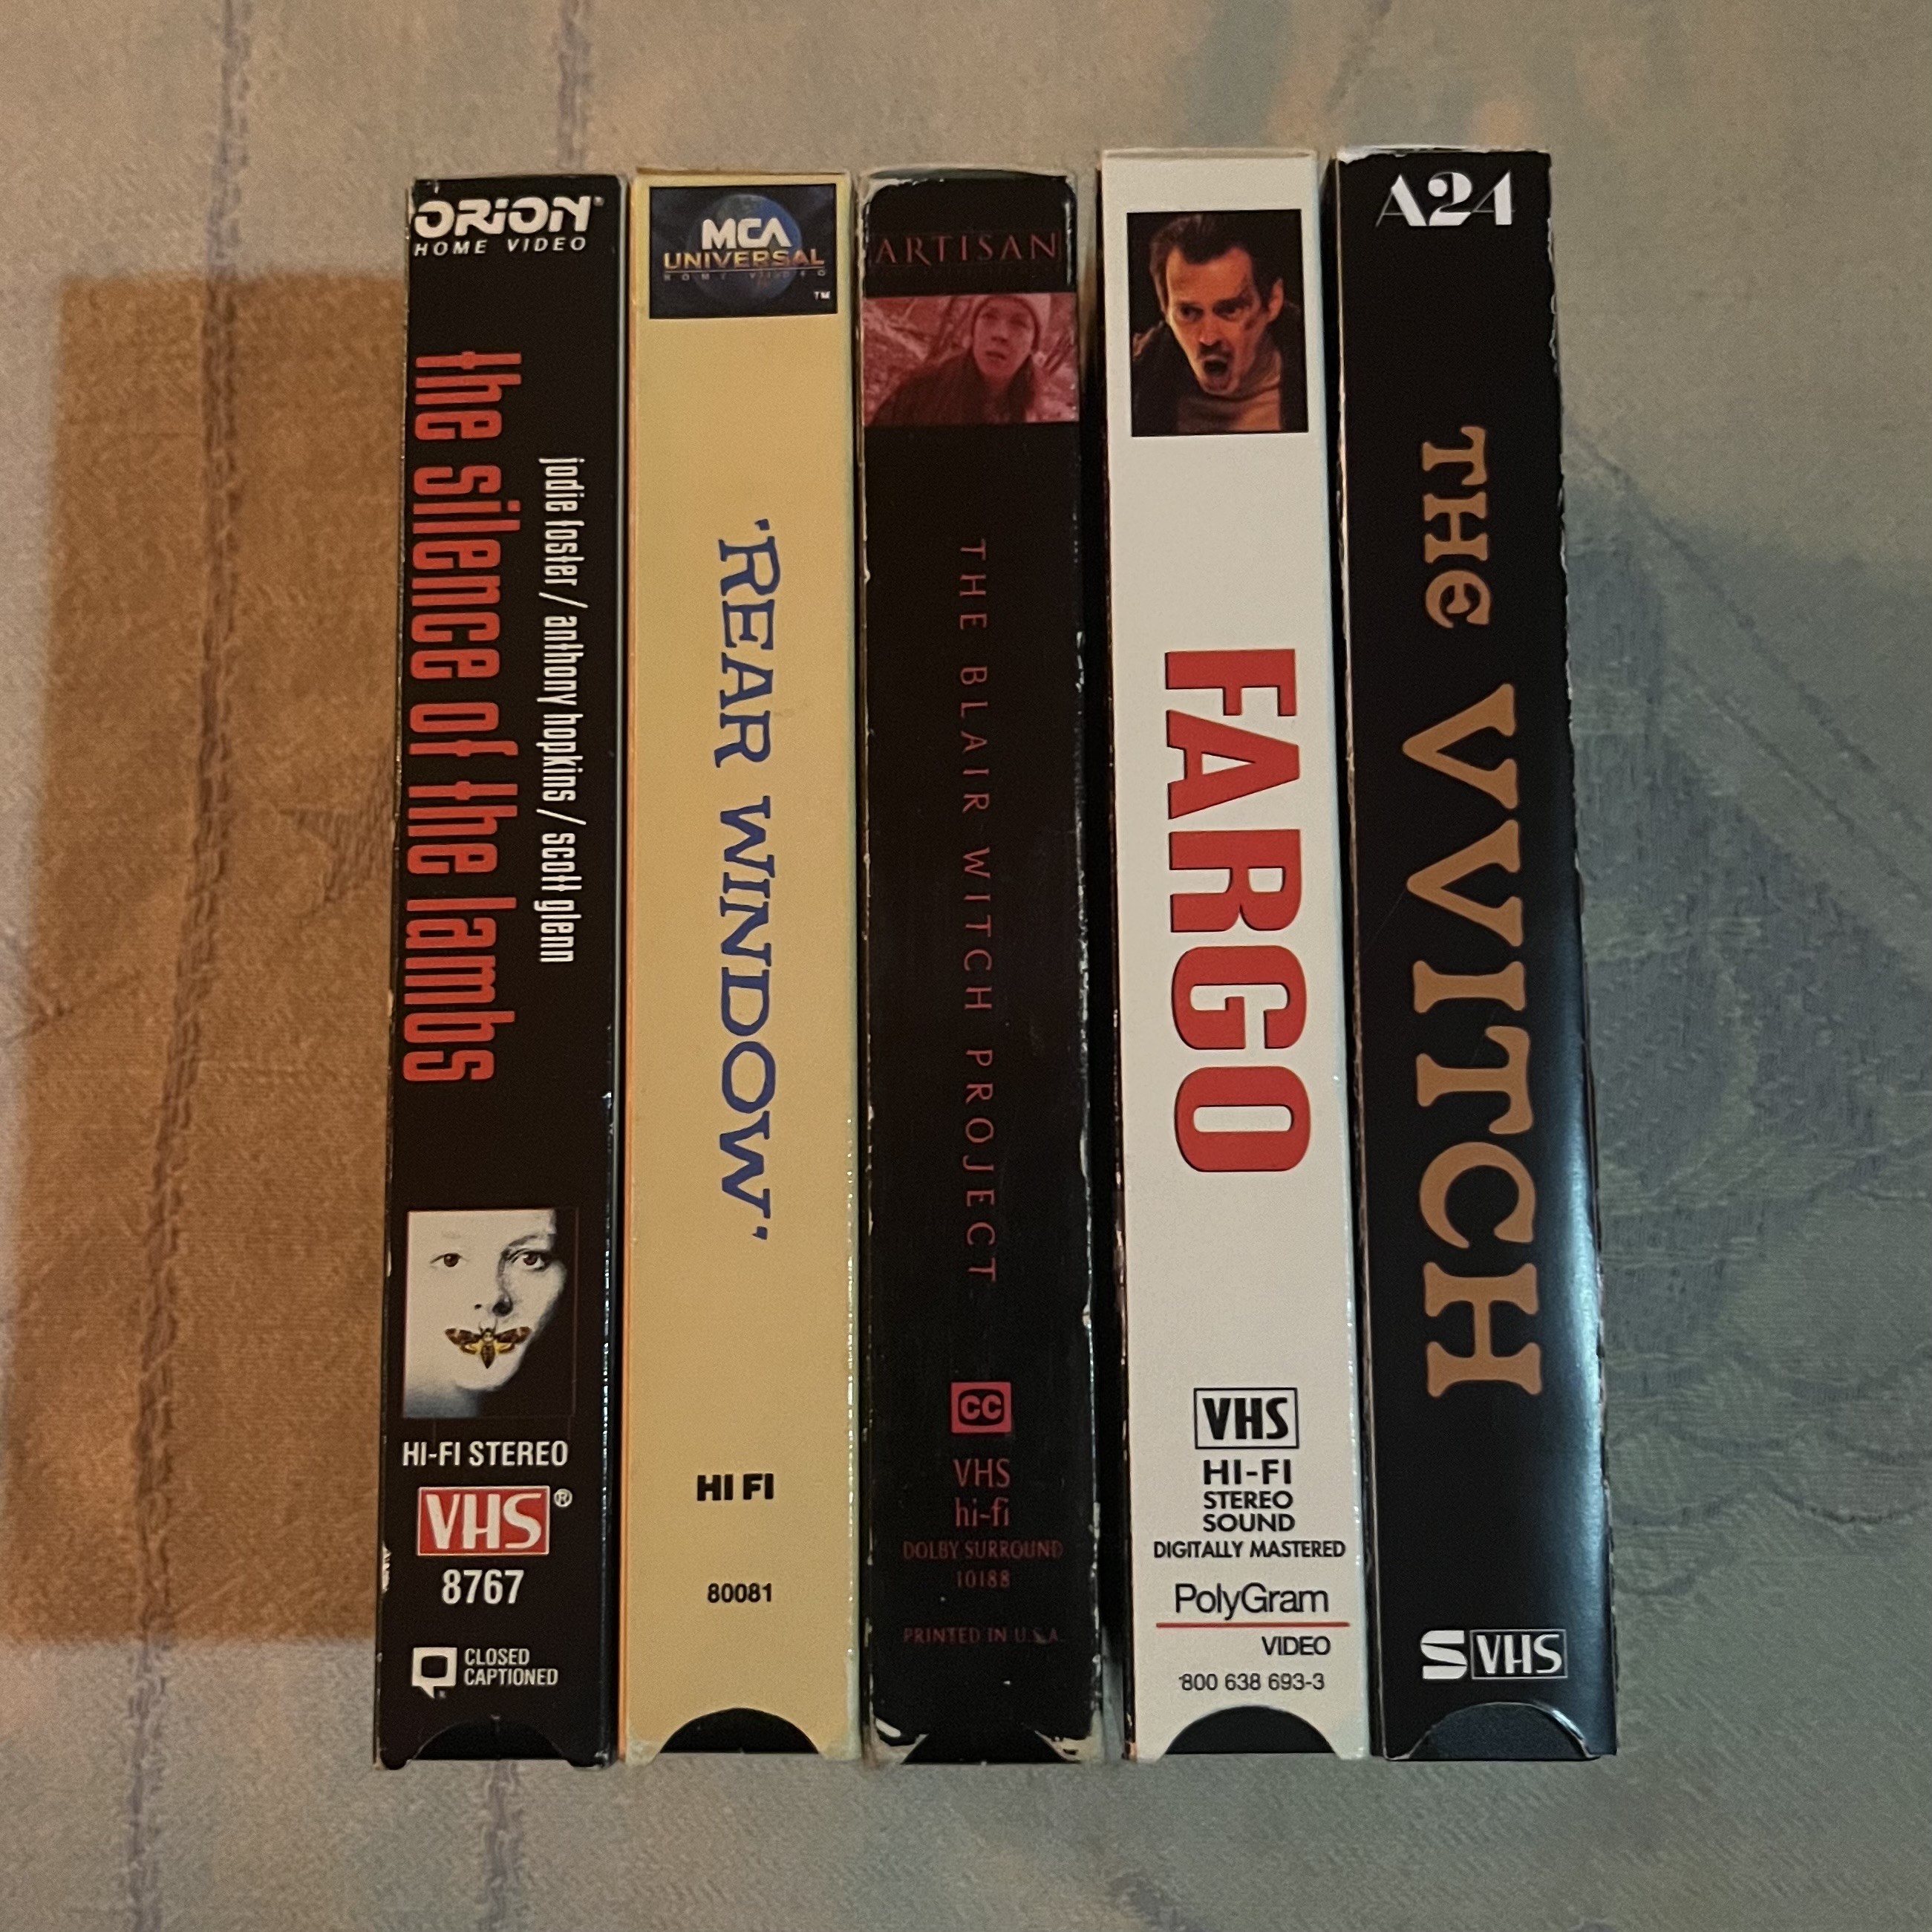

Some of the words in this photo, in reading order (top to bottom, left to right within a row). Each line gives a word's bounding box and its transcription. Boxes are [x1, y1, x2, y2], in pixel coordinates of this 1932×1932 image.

[1375, 169, 1516, 228] A24
[414, 237, 487, 257] HOME
[507, 236, 586, 252] VIDEO
[701, 217, 793, 250] MCA
[875, 232, 1056, 266] ARTISAN
[664, 247, 825, 270] UNIVERSAL
[414, 350, 522, 440] the
[538, 457, 585, 512] jodie
[544, 520, 585, 587] foster
[410, 465, 521, 679] silence
[959, 539, 988, 630] THE
[536, 616, 584, 706] anthony
[408, 702, 519, 757] of
[960, 666, 990, 813] BLAIR
[535, 713, 584, 802] hopkins
[406, 780, 518, 875] the
[541, 832, 582, 892] scott
[963, 846, 993, 1009] WITCH
[1164, 648, 1311, 1173] FARGO
[533, 899, 582, 963] glenn
[402, 897, 517, 1082] lambs
[962, 1049, 996, 1282] PROJECT
[1202, 1397, 1289, 1440] VHS
[402, 1441, 461, 1466] HI-FI
[469, 1440, 569, 1467] STEREO
[696, 1474, 734, 1502] HI
[743, 1472, 774, 1501] FI
[953, 1458, 1011, 1488] VHS
[1203, 1458, 1292, 1486] HI-FI
[955, 1496, 1010, 1527] hi-fi
[1203, 1489, 1294, 1510] STEREO
[425, 1492, 542, 1550] VHS
[1202, 1512, 1296, 1533] SOUND
[902, 1540, 959, 1560] DOLBY
[965, 1539, 1063, 1560] SURROUND
[1153, 1540, 1244, 1559] DIGITALLY
[1249, 1540, 1346, 1559] MASTERED
[441, 1569, 524, 1605] 8767
[707, 1582, 772, 1604] 80081
[957, 1569, 1011, 1588] 10188
[1175, 1582, 1329, 1622] PolyGram
[904, 1627, 981, 1644] PRINTED
[988, 1628, 1007, 1642] IN
[1261, 1635, 1331, 1657] VIDEO
[464, 1648, 530, 1666] CLOSED
[463, 1668, 558, 1686] CAPTIONED
[1224, 1672, 1262, 1691] 638
[1267, 1672, 1325, 1691] 693-3
